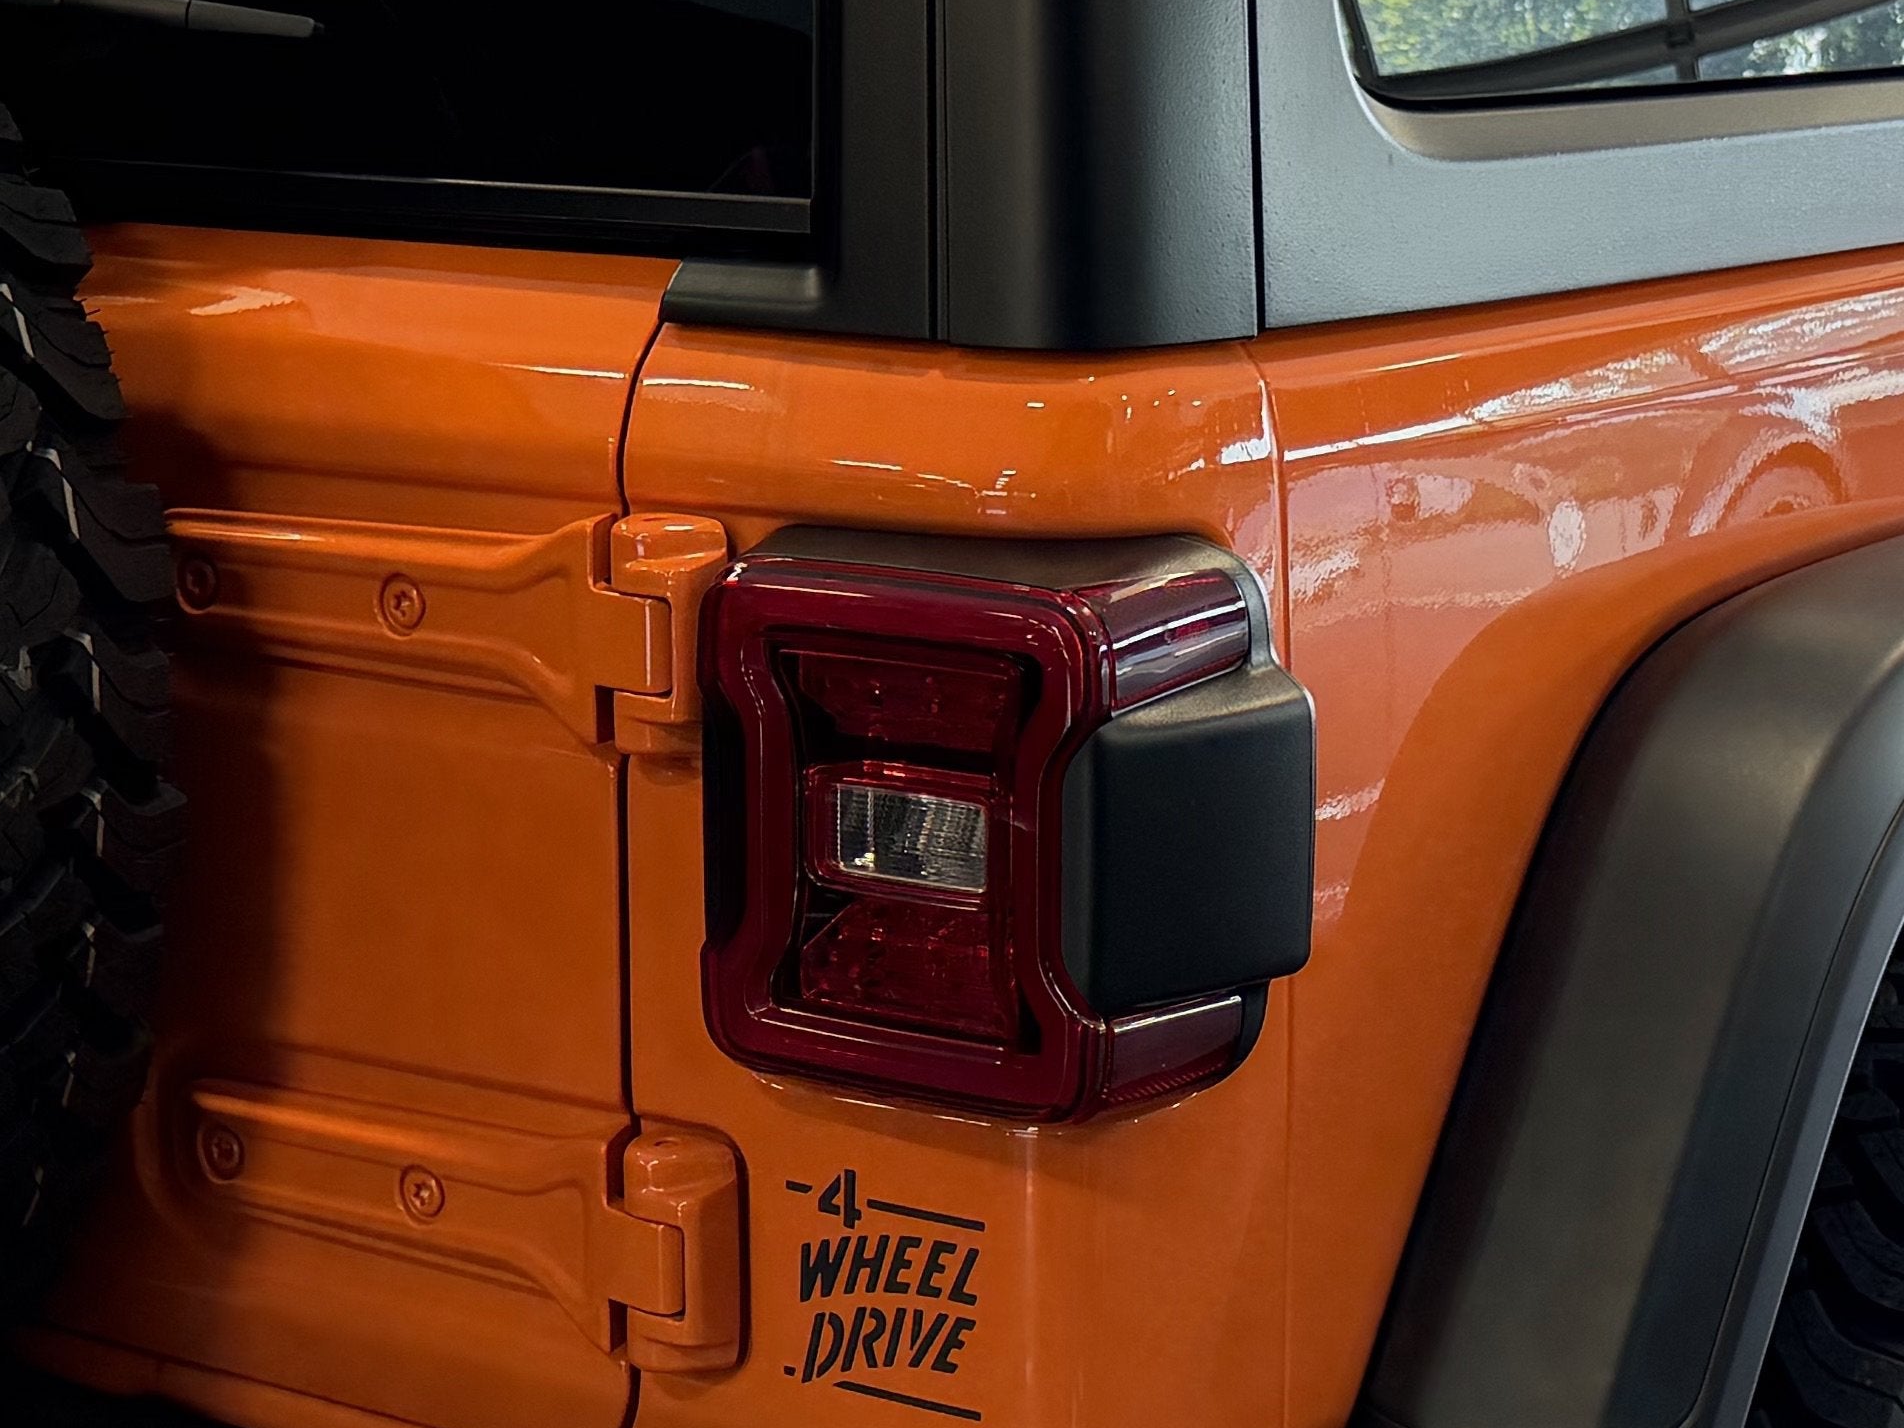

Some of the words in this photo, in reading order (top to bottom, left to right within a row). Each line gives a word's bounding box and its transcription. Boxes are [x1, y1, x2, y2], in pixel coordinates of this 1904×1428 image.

[818, 1169, 862, 1229] 4
[800, 1234, 979, 1306] WHEEL
[801, 1306, 976, 1384] DRIVE
